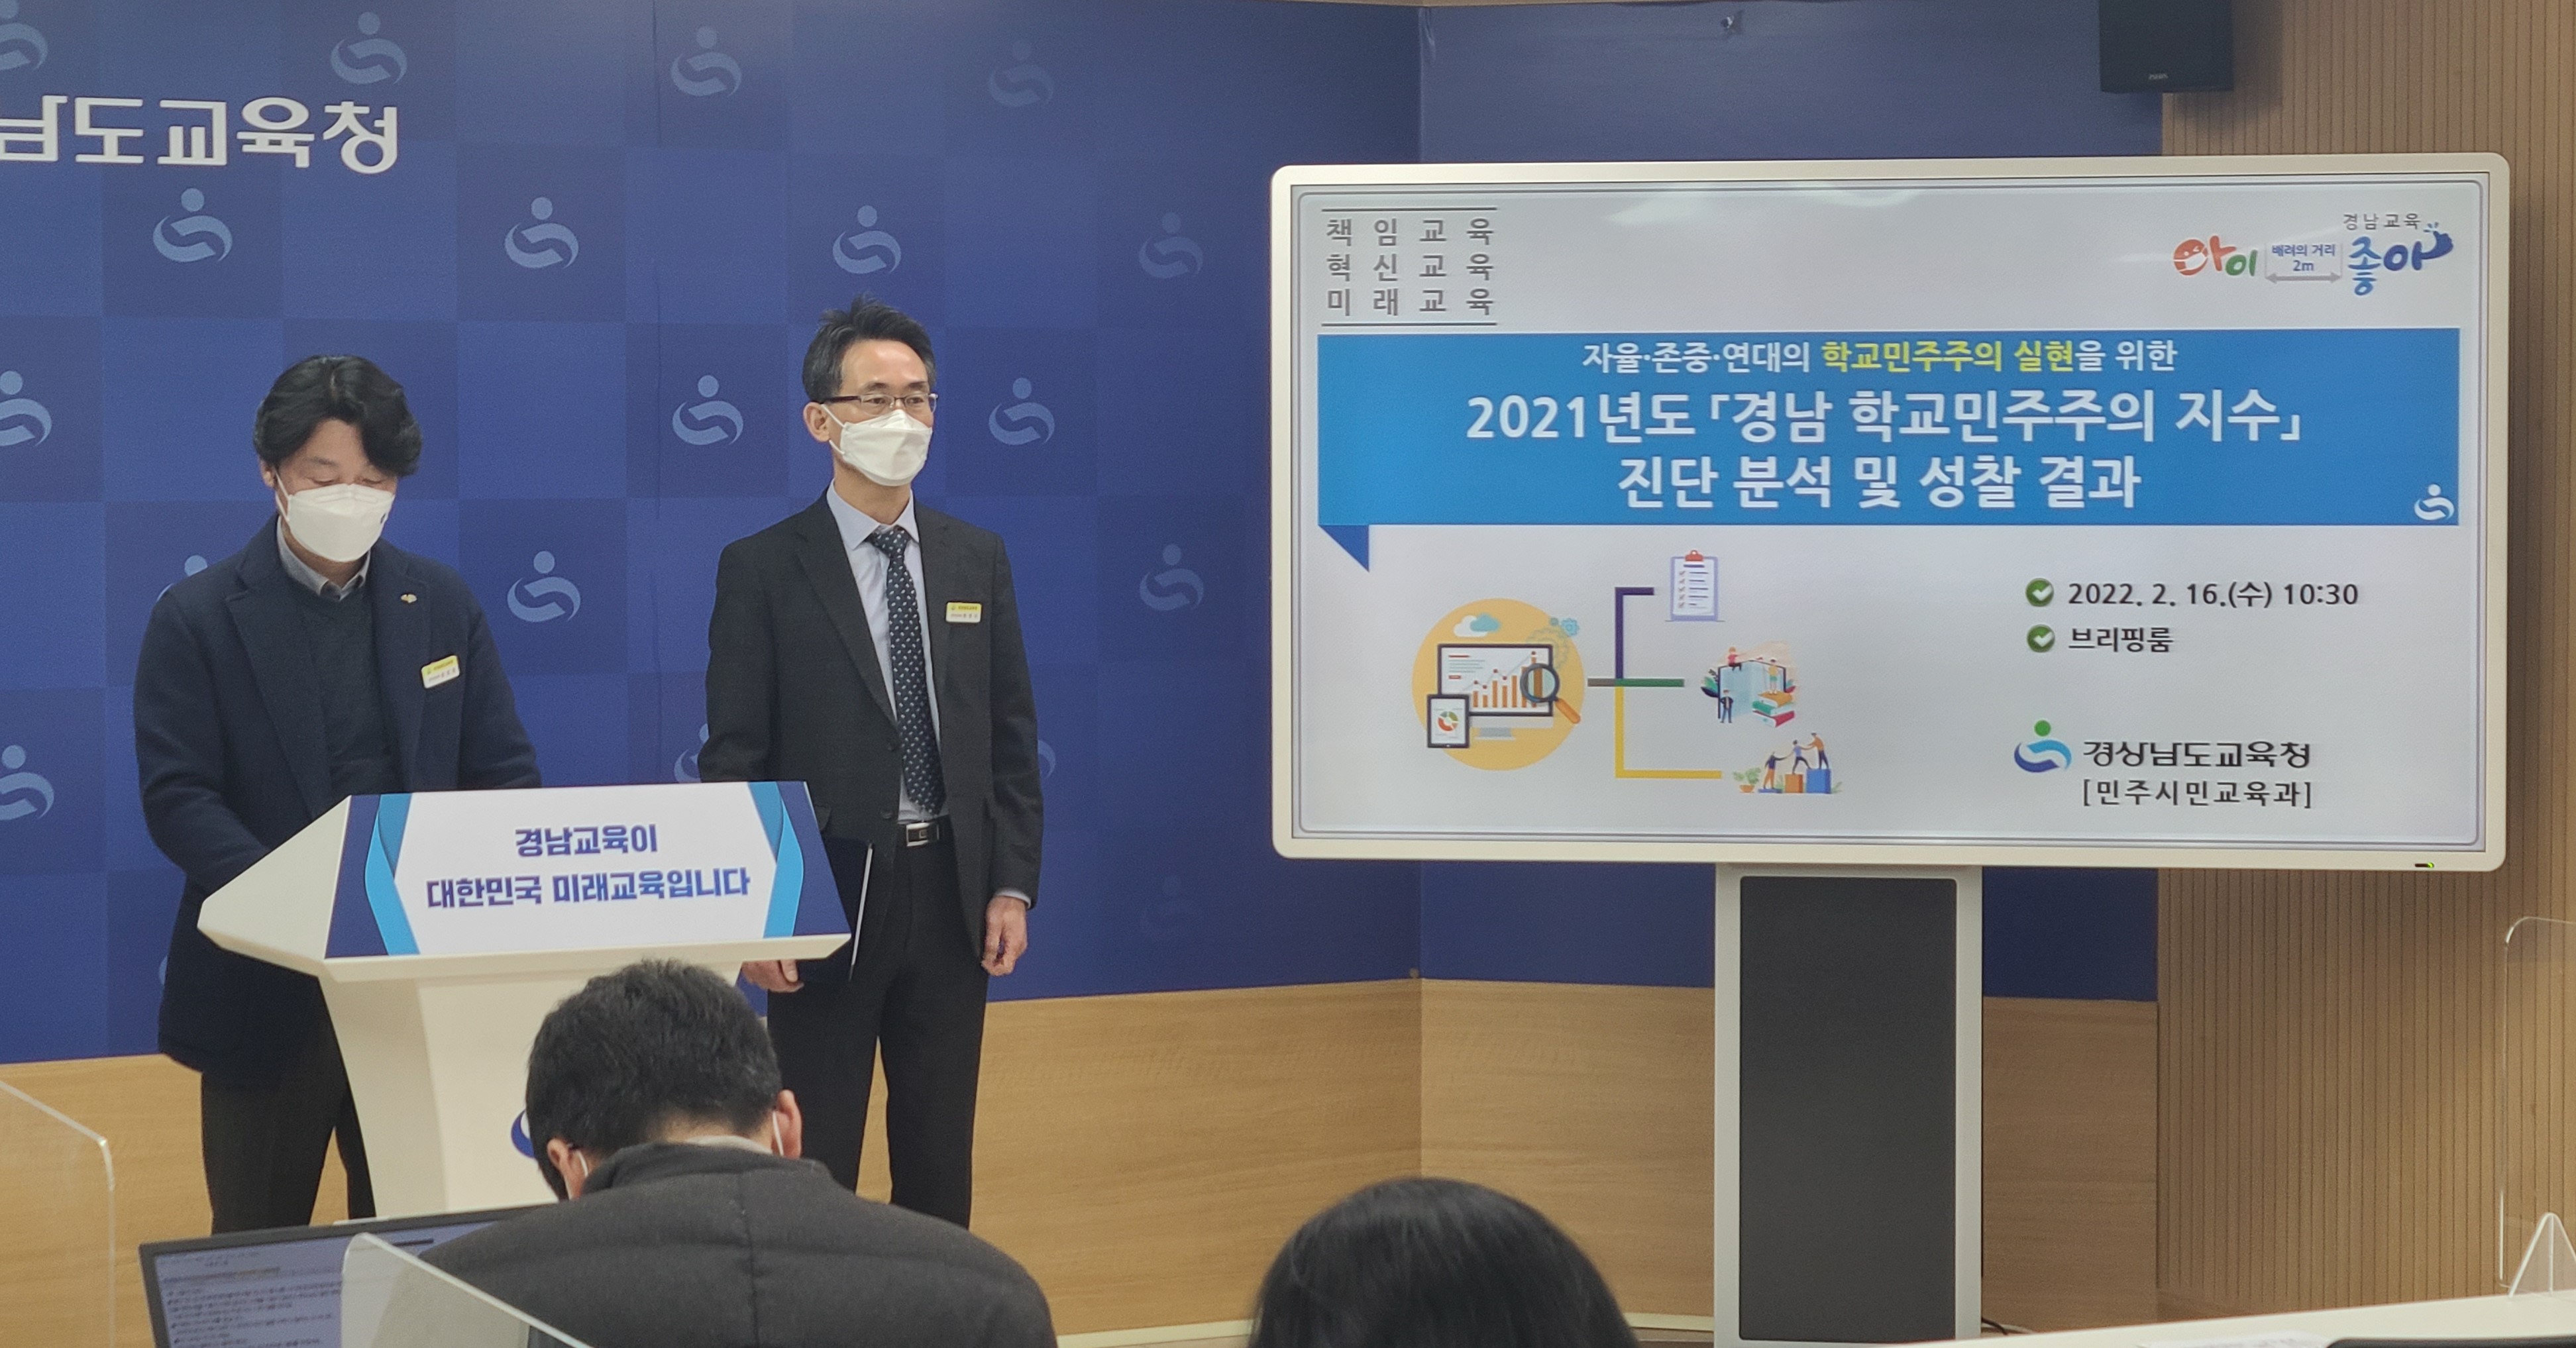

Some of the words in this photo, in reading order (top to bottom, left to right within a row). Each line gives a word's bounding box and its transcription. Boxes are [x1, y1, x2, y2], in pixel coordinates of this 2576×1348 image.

[1326, 218, 1494, 247] 책임교육
[2343, 213, 2421, 231] 경남교육
[2173, 235, 2258, 276] 아이
[2348, 229, 2454, 296] 좋아
[2271, 244, 2308, 257] 배려의
[2312, 243, 2335, 257] 거리
[1326, 253, 1494, 282] 혁신교육
[2292, 260, 2315, 272] 2m
[1326, 287, 1494, 316] 미래교육
[1821, 340, 2002, 372] 학교민주주의
[2014, 340, 2106, 372] 실현을
[2114, 340, 2178, 371] 위한
[1466, 391, 1696, 443] 2021년도
[1848, 389, 2155, 443] 학교민주주의
[1617, 456, 1719, 508] 진단
[1733, 456, 1831, 508] 분석
[1854, 456, 1901, 508] 및
[1919, 456, 2022, 508] 성찰
[2039, 455, 2142, 508] 결과
[2068, 583, 2143, 607] 2022.
[2152, 583, 2176, 607] 2.
[2186, 581, 2273, 608] 16.(수)
[2284, 583, 2359, 605] 10:30
[2068, 627, 2174, 652] 브리핑룸
[2082, 741, 2311, 768] 경상남도교육청
[2083, 780, 2312, 809] [민주시민교육과]
[515, 824, 657, 857] 경남교육이
[426, 874, 542, 908] 대한민국
[552, 867, 751, 904] 미래교육입니다
